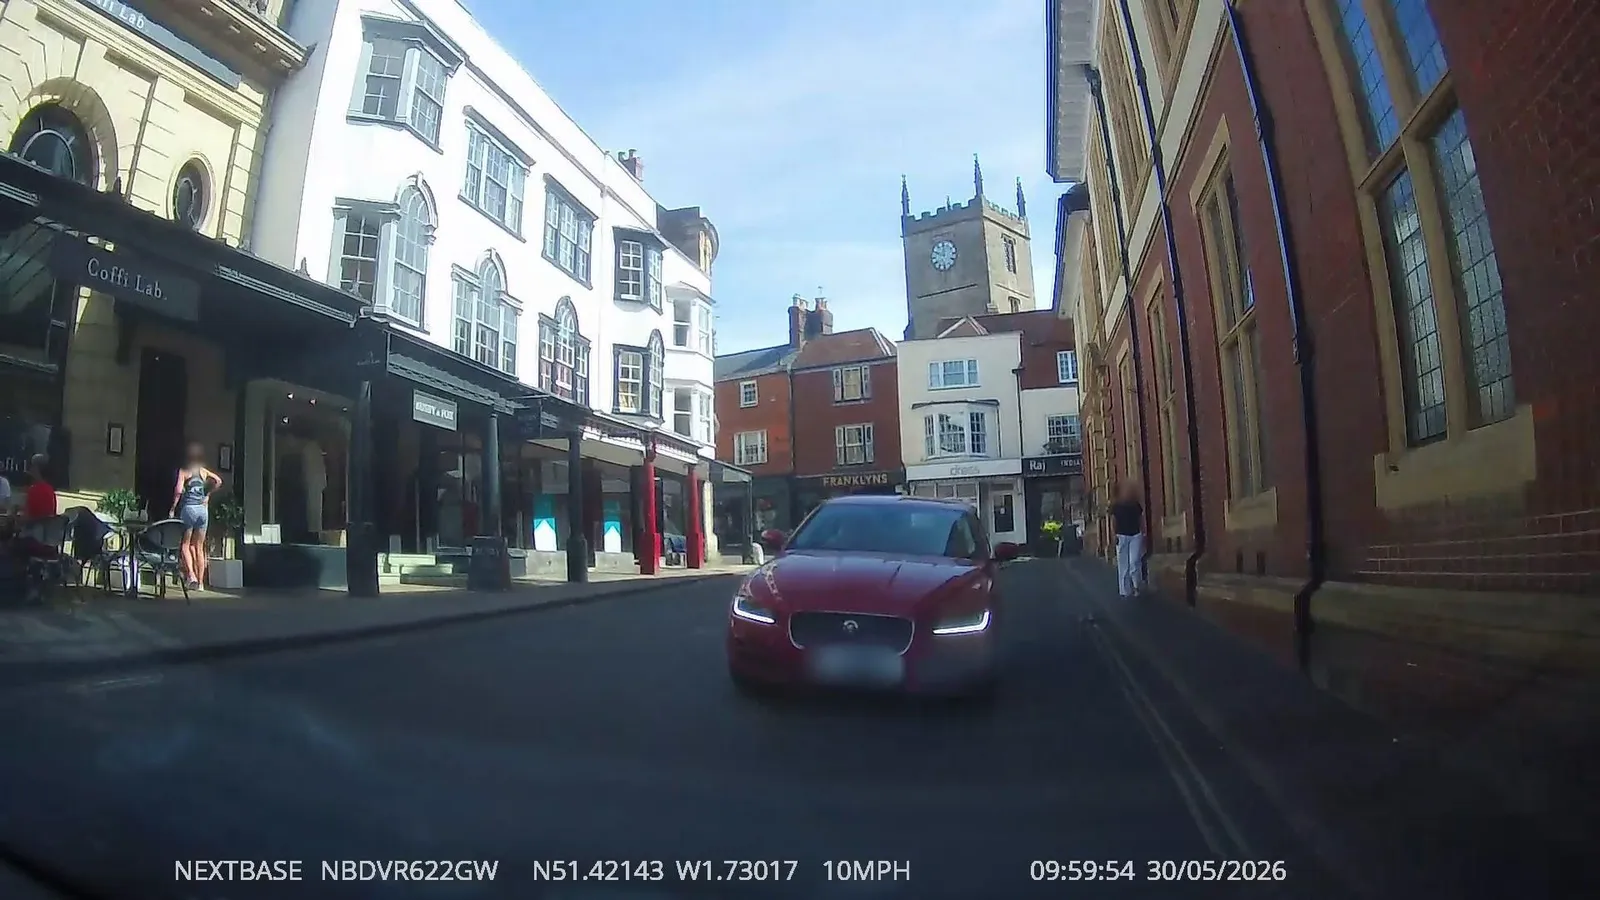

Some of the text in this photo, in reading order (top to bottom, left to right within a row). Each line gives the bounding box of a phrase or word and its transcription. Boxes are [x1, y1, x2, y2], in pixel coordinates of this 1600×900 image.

[87, 257, 167, 301] Coffi Lab.
[1029, 459, 1046, 472] Raj
[823, 473, 888, 487] FRANKLYNS
